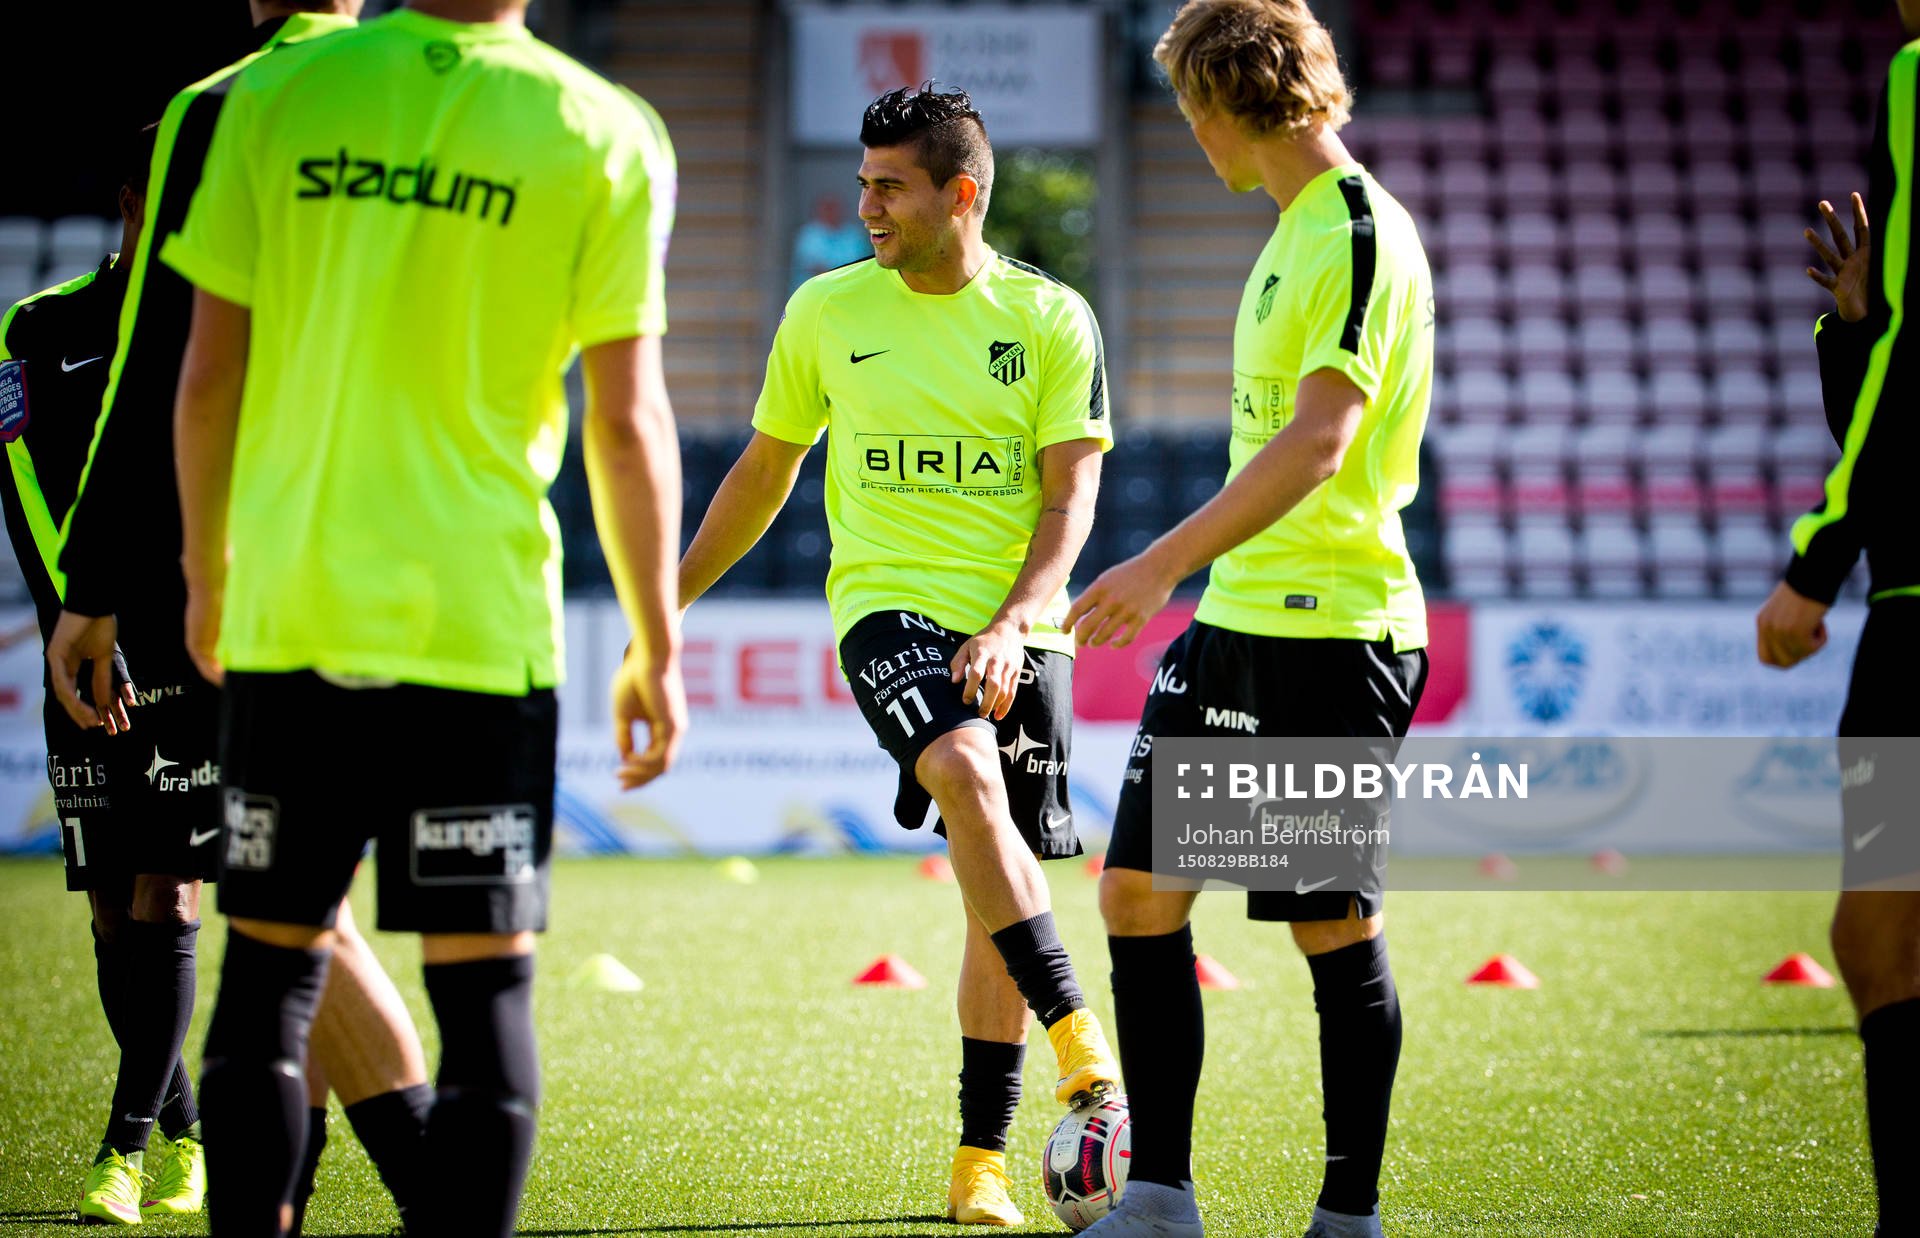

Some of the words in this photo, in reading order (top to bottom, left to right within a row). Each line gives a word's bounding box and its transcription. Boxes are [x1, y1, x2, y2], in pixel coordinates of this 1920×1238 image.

[1012, 440, 1021, 482] BYGG
[961, 487, 1023, 497] ANDERSSON
[859, 643, 943, 689] Varis
[873, 665, 951, 706] Förvaltning
[886, 685, 934, 738] 11
[1026, 753, 1068, 777] bravi
